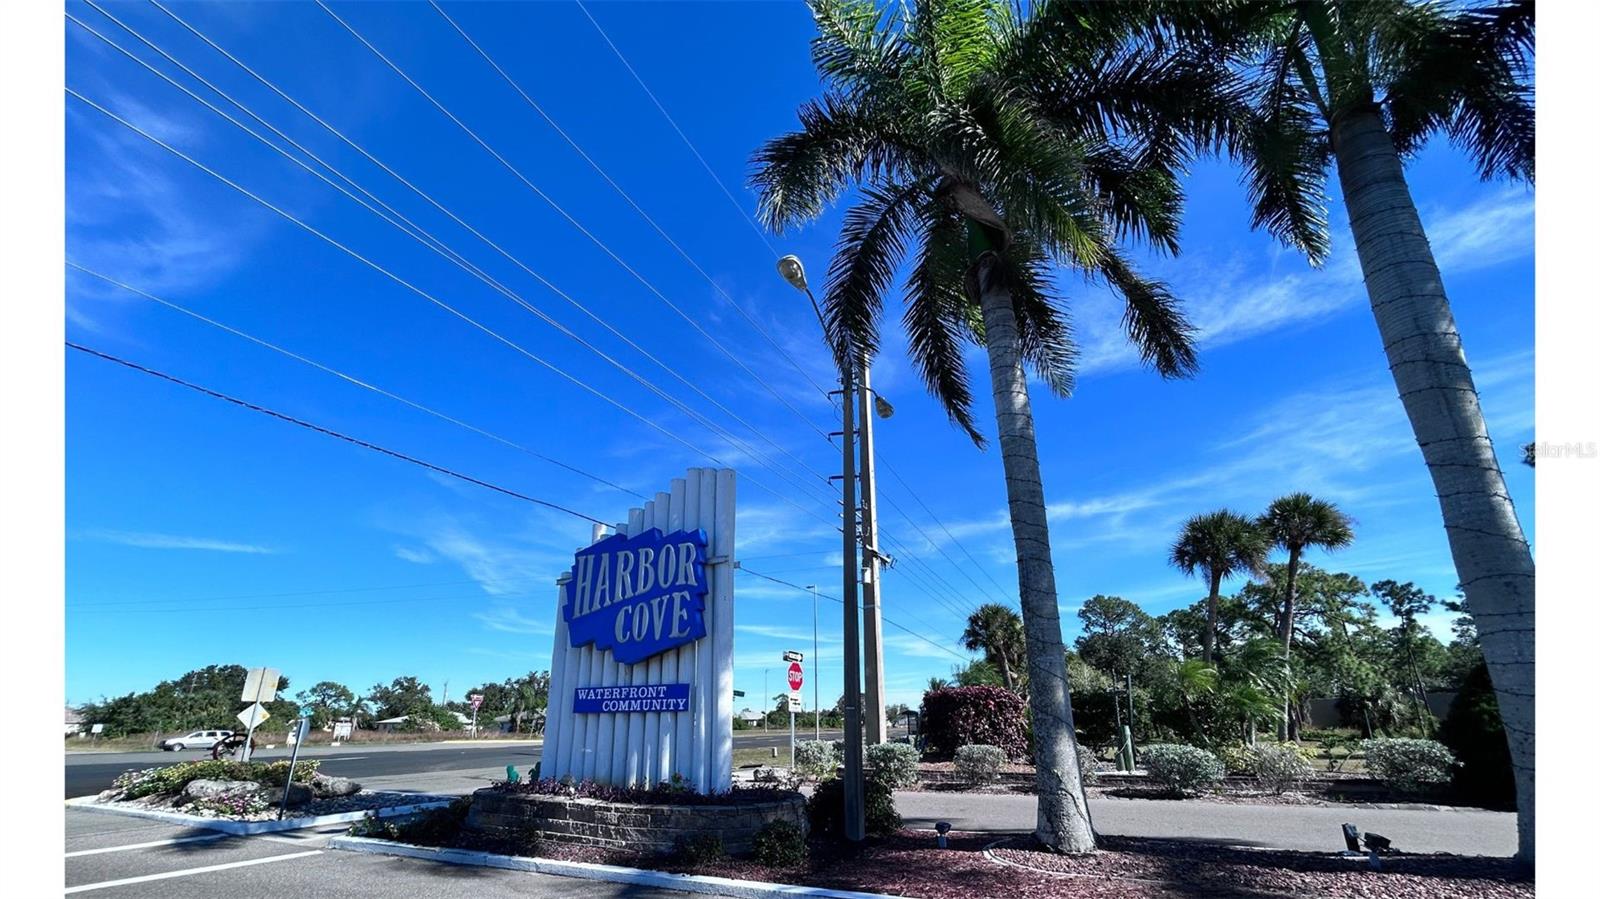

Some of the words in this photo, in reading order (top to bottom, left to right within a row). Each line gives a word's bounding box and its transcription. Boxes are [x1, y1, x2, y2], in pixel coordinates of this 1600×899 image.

[573, 542, 698, 619] HARBOR
[614, 591, 691, 643] COVE
[789, 670, 802, 682] STOP
[577, 686, 667, 700] WATERFRONT
[602, 698, 687, 711] COMMUNITY
